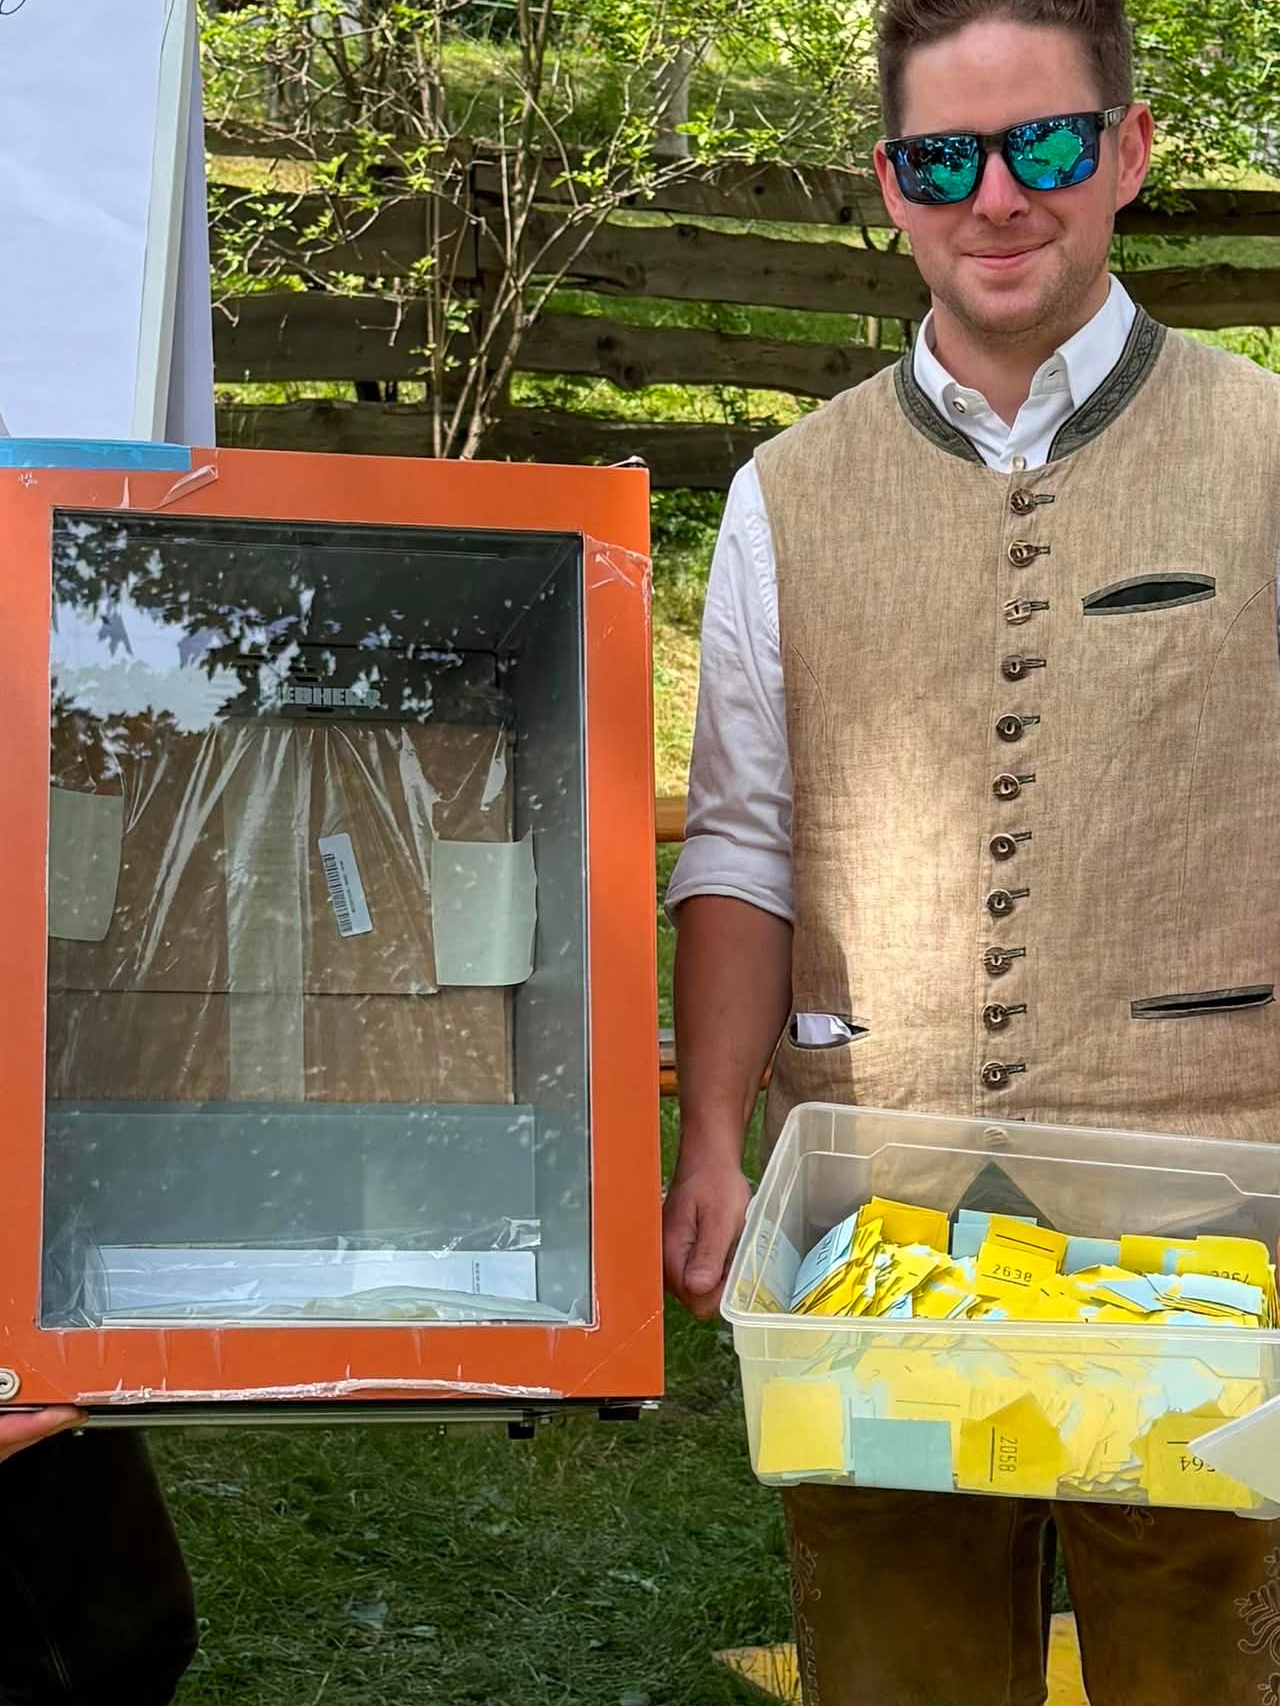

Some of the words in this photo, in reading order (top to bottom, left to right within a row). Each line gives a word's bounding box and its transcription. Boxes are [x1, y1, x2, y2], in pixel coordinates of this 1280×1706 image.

[992, 1263, 1032, 1282] 2638
[999, 1436, 1018, 1472] 2058
[1179, 1456, 1216, 1472] 64
